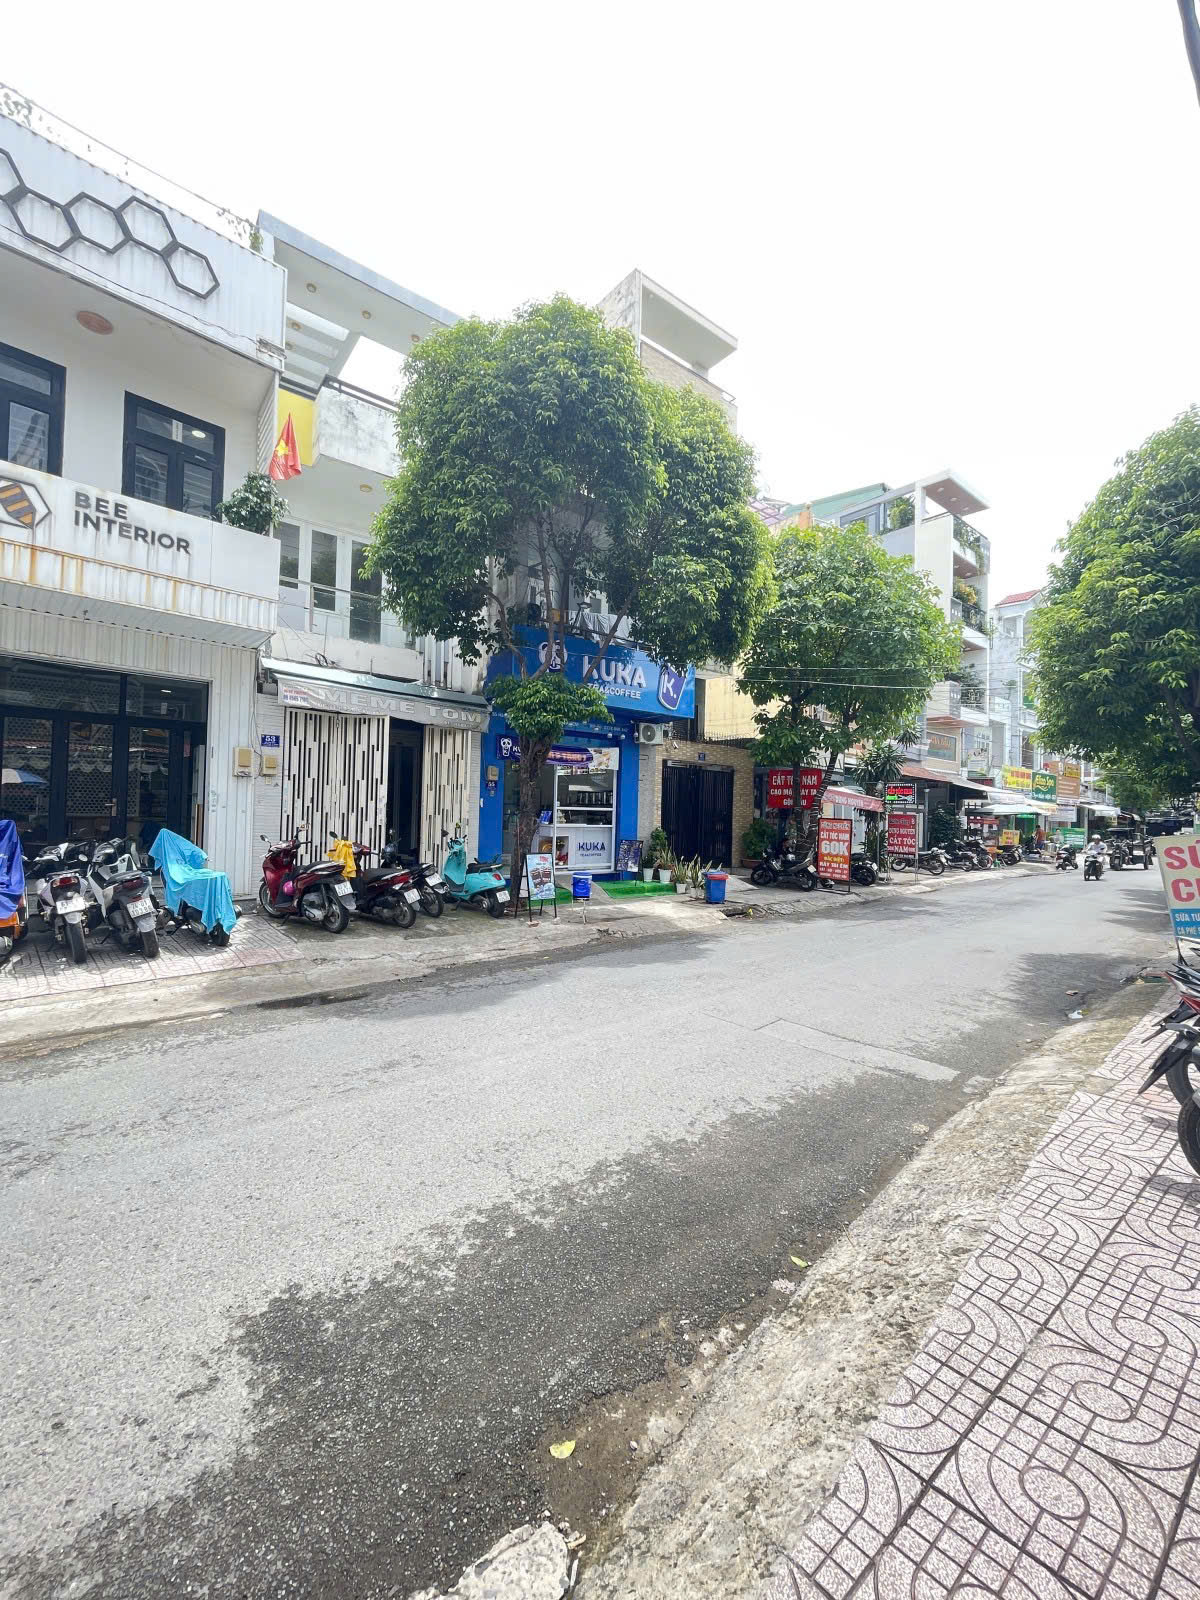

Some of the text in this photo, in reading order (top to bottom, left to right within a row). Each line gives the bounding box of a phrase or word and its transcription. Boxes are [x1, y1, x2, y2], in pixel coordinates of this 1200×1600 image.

[75, 491, 128, 520] BEE
[74, 510, 191, 555] INTERIOR
[323, 688, 415, 713] MEME
[425, 704, 481, 722] TOM
[578, 842, 606, 851] KUKA
[821, 840, 849, 856] 60K
[1171, 878, 1200, 902] C
